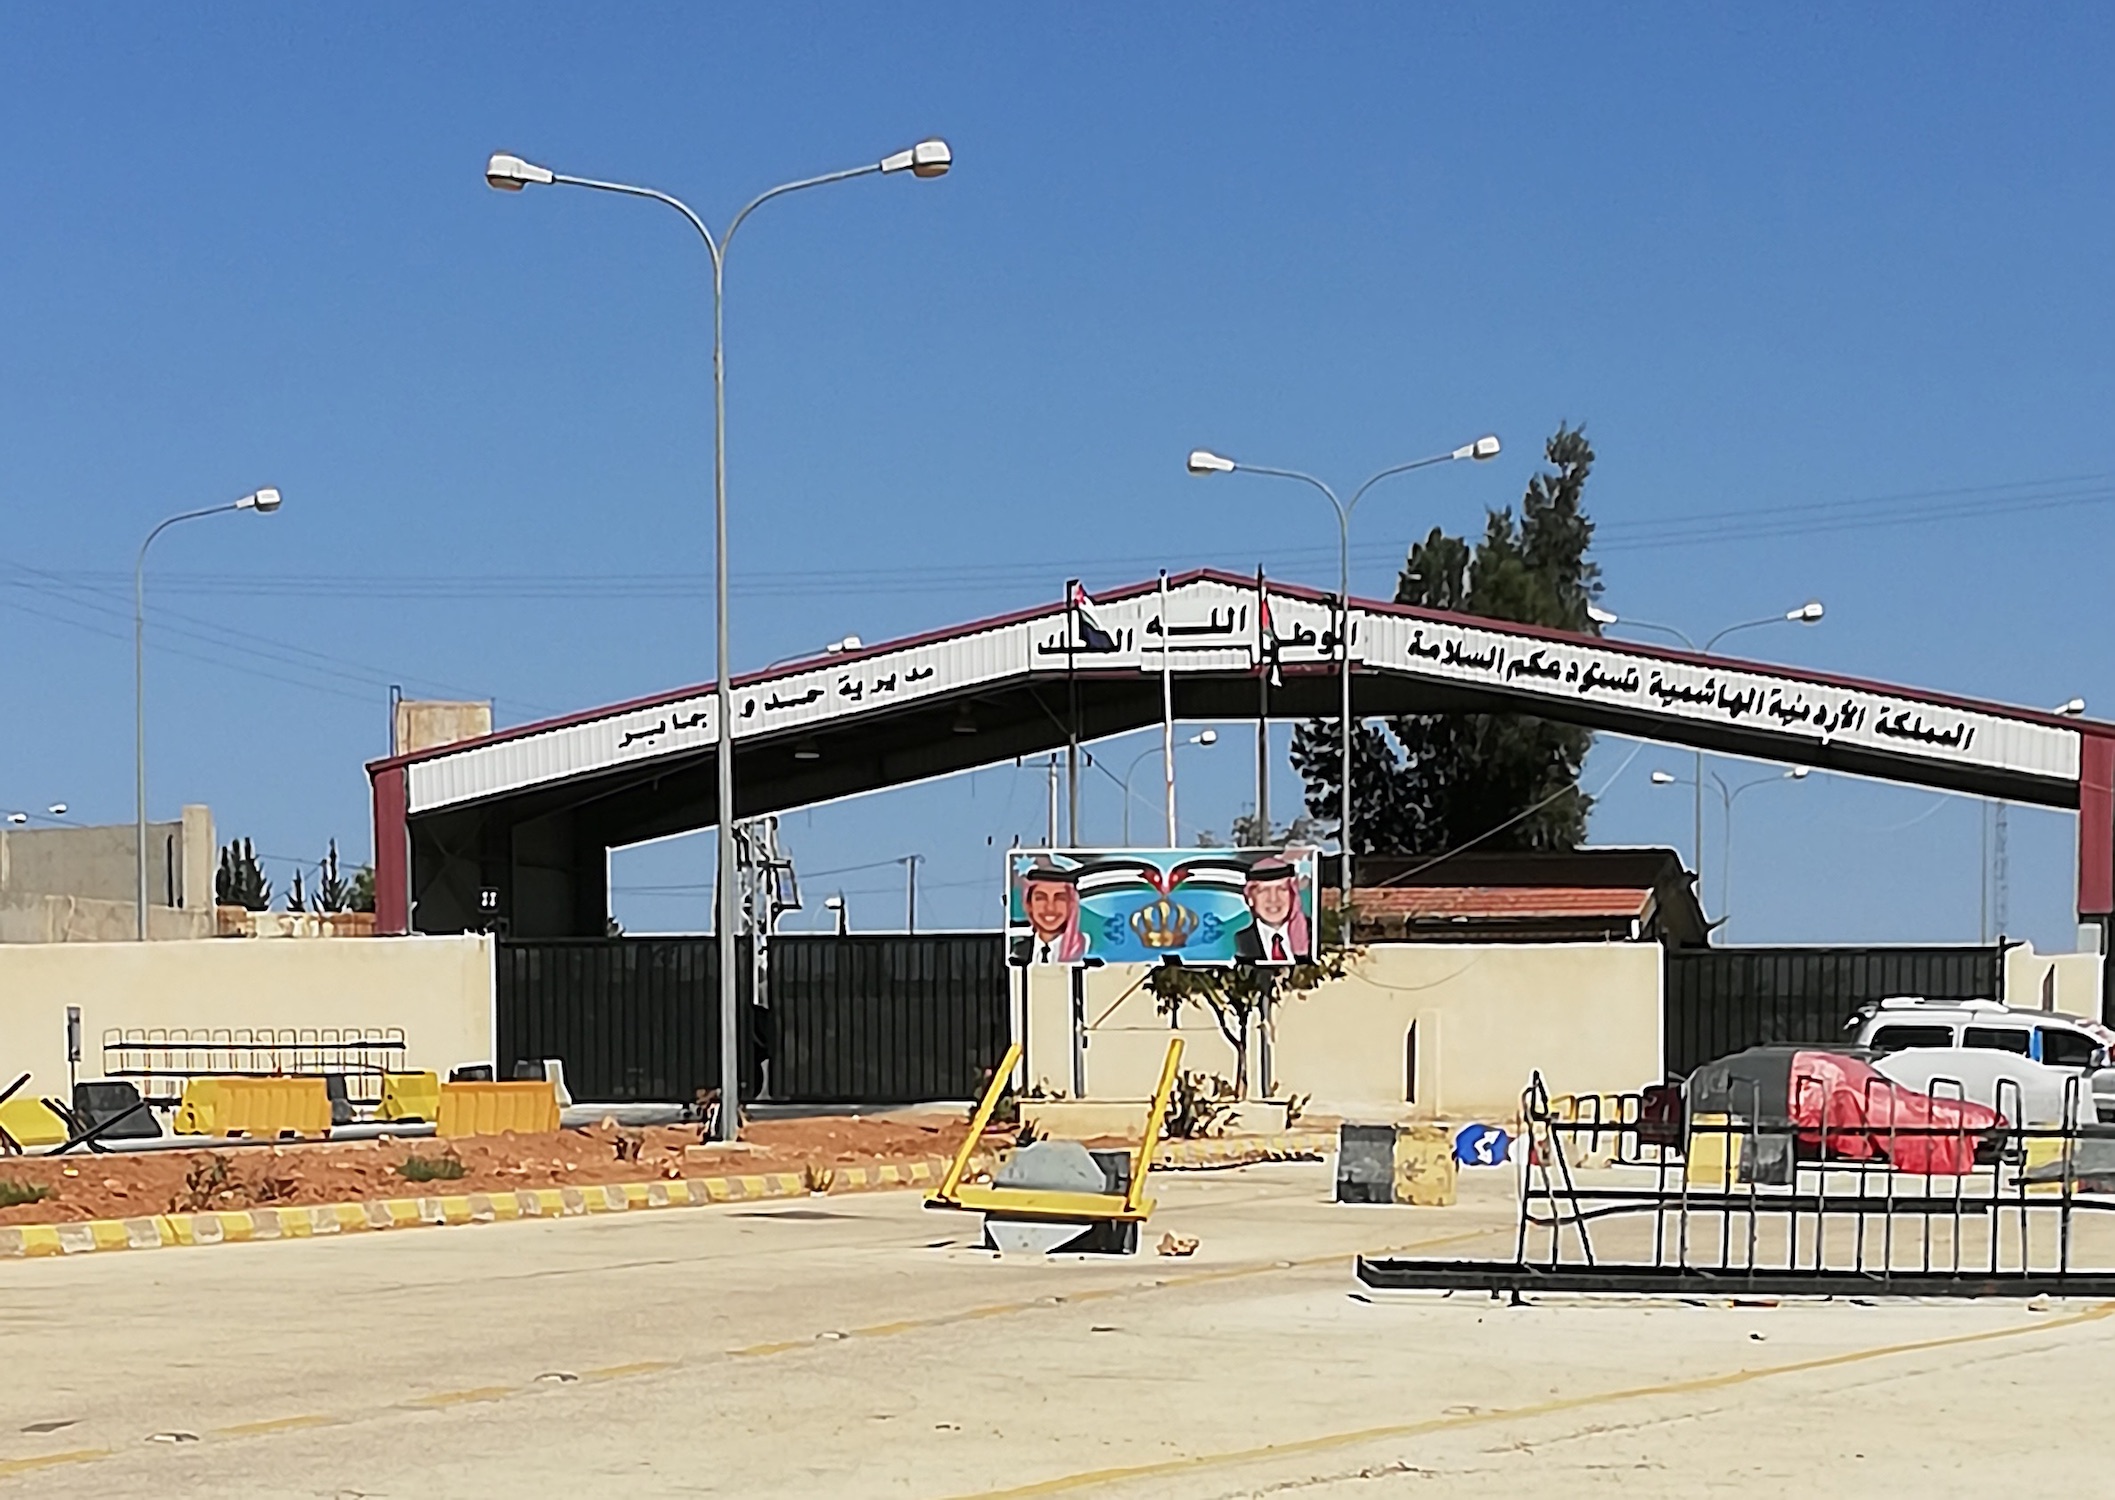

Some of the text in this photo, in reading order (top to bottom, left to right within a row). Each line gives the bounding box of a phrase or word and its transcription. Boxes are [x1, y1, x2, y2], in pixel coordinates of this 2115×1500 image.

[1145, 605, 1248, 637] الله
[1407, 630, 1505, 674] السلامة
[617, 667, 935, 749] مديرية حدو جابر
[1648, 670, 1766, 719] الهاشمية
[1768, 688, 1867, 733] الأردنية
[1874, 705, 1976, 750] المملكة
